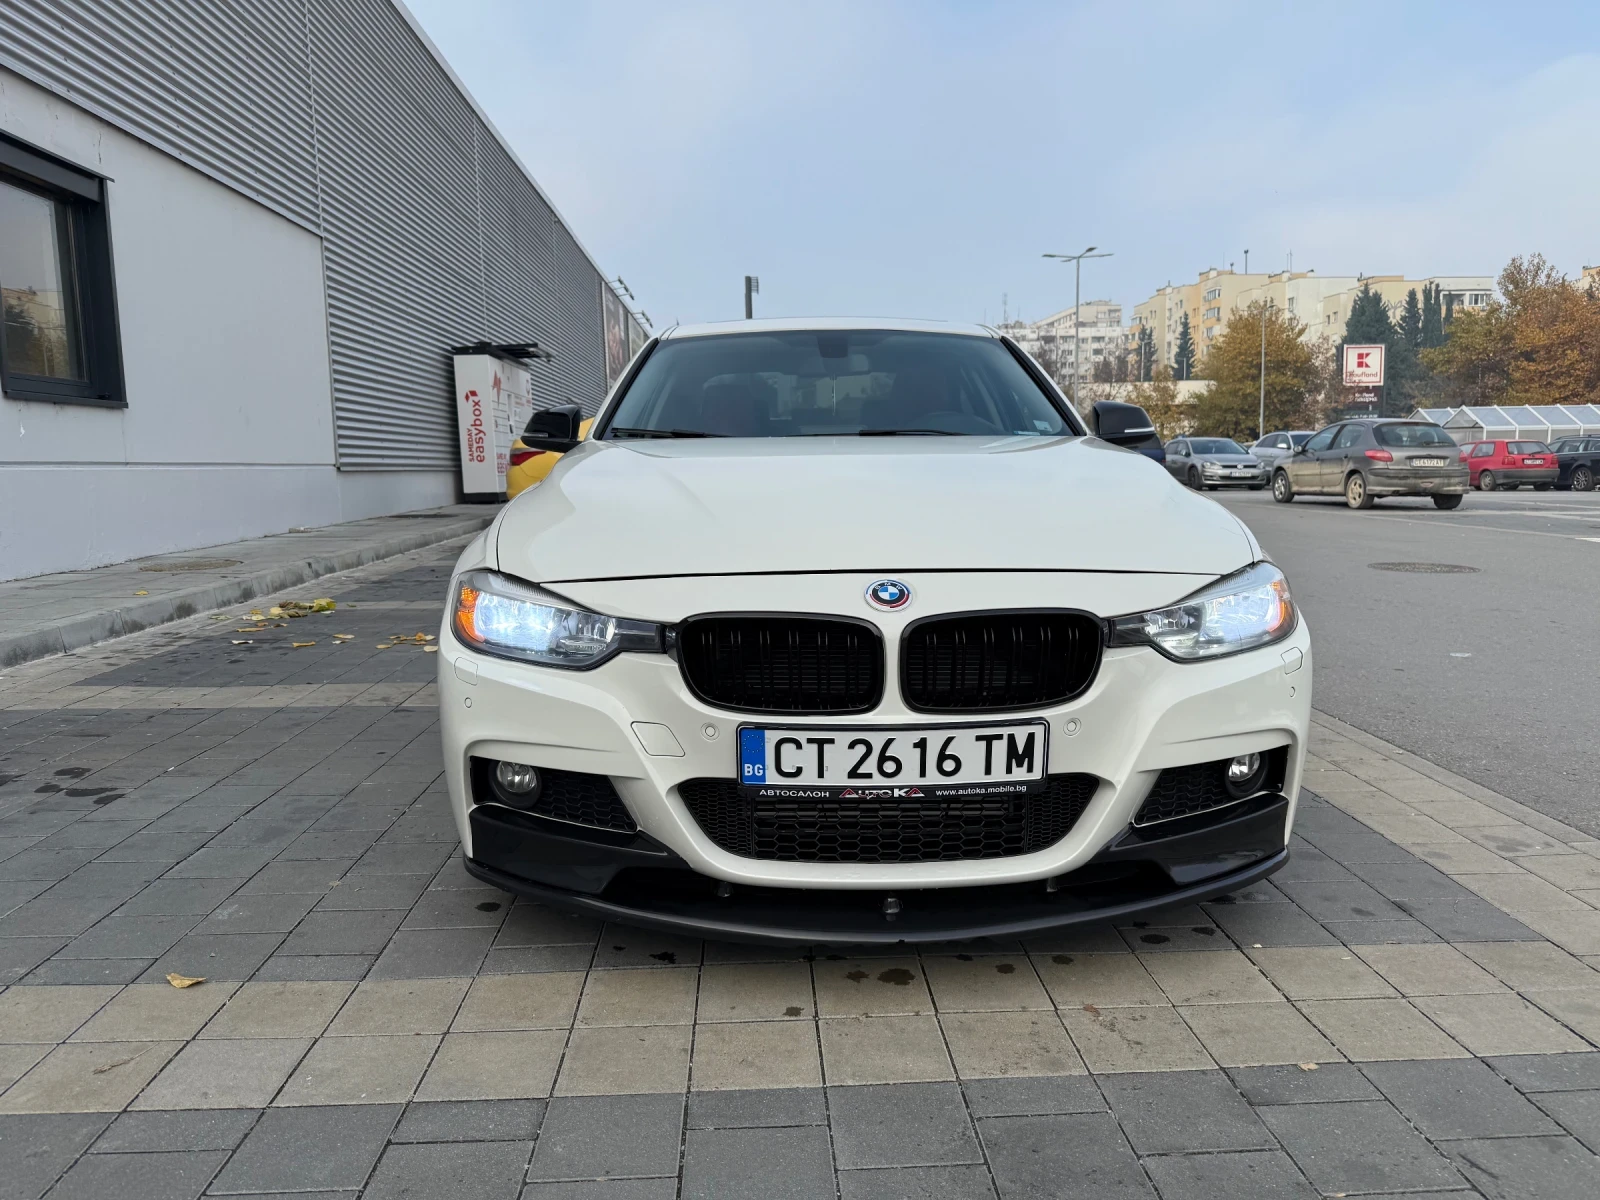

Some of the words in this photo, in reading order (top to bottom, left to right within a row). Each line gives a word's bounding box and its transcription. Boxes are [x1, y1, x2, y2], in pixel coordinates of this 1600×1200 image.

[470, 399, 487, 463] easybox
[466, 428, 475, 462] SAMEDAY
[773, 737, 836, 779] CT
[847, 735, 962, 779] 2616
[975, 731, 1036, 776] TM
[744, 763, 764, 777] BG
[759, 789, 829, 798] АВТОСАЛОН
[935, 784, 1027, 796] www.autoka.mobile.bg
